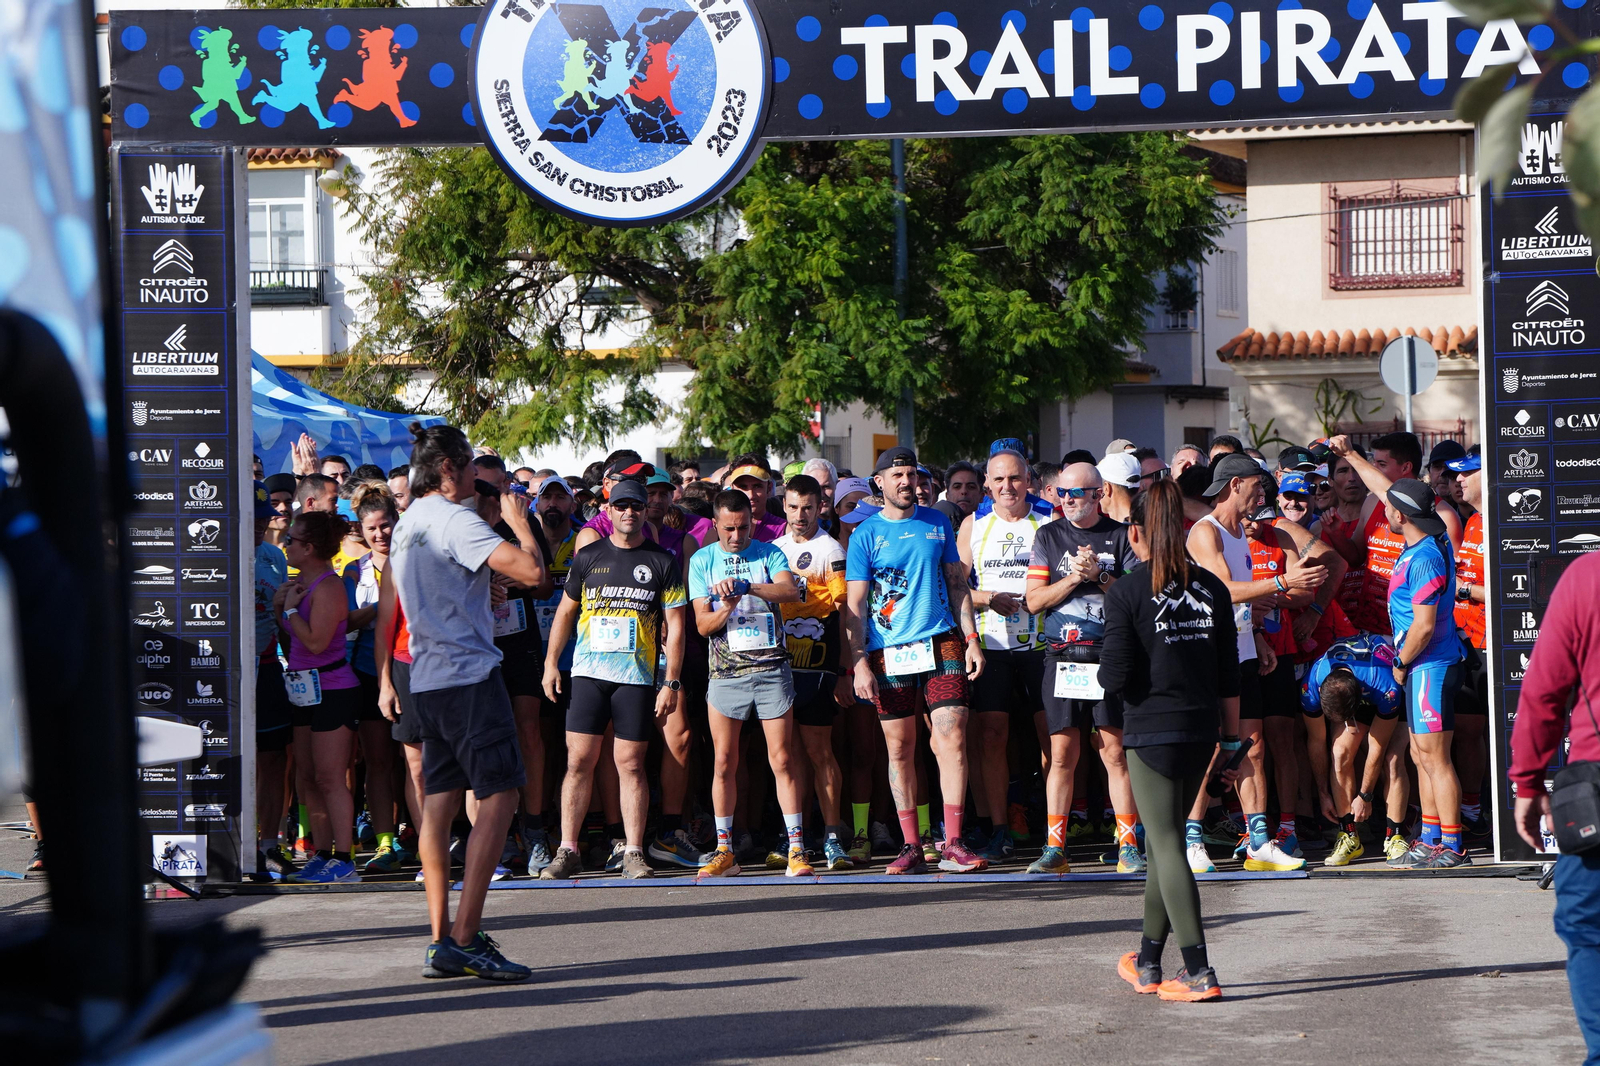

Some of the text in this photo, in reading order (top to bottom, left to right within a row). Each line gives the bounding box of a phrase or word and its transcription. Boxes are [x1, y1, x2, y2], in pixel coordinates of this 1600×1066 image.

[840, 17, 1140, 104] TRAIL
[1176, 1, 1541, 93] PIRATA
[706, 87, 747, 158] 2023
[493, 78, 683, 203] SIERRA SAN CRISTOBAL
[1511, 176, 1551, 186] AUTISMO
[141, 214, 206, 224] AUTISMO CÁDIZ
[1501, 234, 1592, 250] LIBERTIUM
[1505, 248, 1590, 260] AUTOCARAVANAS
[140, 288, 209, 304] INAUTO
[1512, 330, 1585, 347] INAUTO
[132, 352, 219, 364] LIBERTIUM
[136, 366, 215, 374] AUTOCARAVANAS
[1521, 374, 1569, 382] Ayuntamiento
[1579, 372, 1597, 380] Jerez
[149, 408, 194, 416] Ayuntamiento
[204, 408, 221, 416] Jerez
[150, 414, 173, 422] Deportes
[1567, 414, 1600, 428] CAV
[1501, 426, 1545, 436] RECOSUR
[140, 449, 172, 462] CAV
[182, 458, 224, 468] RECOSUR
[1367, 535, 1405, 550] Movijerez
[724, 556, 750, 568] TRAIL
[999, 570, 1026, 580] JEREZ
[586, 586, 656, 602] LA QUEDADA
[190, 602, 220, 618] TC
[598, 628, 620, 639] 519
[736, 626, 760, 638] 906
[1155, 622, 1169, 633] De
[1513, 630, 1541, 640] BAMB
[136, 654, 171, 668] alpha
[191, 655, 220, 666] BAMBÚ
[894, 650, 918, 663] 676
[1066, 674, 1089, 687] 905
[138, 690, 172, 700] LUGO
[162, 860, 203, 870] PIRATA
